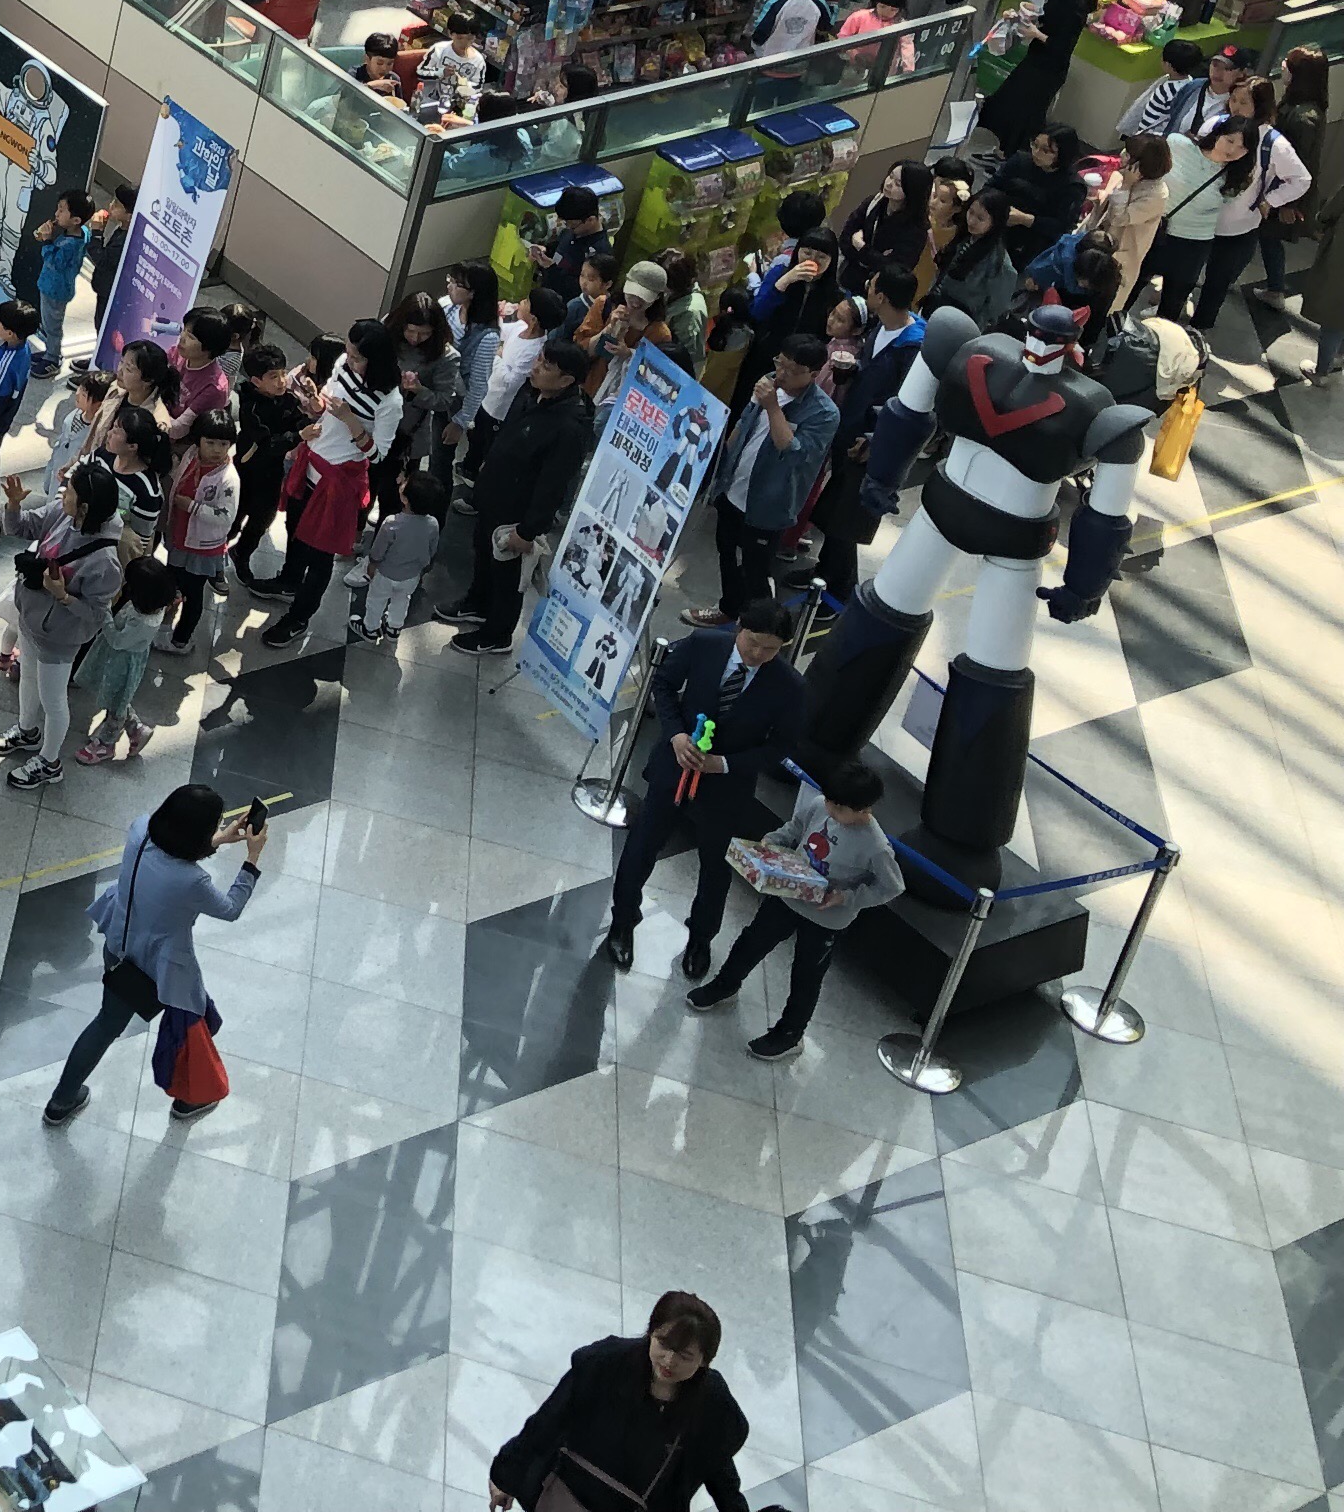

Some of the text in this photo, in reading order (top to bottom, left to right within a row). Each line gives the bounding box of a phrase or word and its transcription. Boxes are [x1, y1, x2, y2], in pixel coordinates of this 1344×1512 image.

[191, 135, 223, 172] 과학의
[209, 139, 226, 157] 2019
[204, 166, 220, 189] 날
[160, 211, 193, 249] 포토존
[623, 387, 670, 437] 로보트
[609, 429, 652, 473] 제작과정
[617, 412, 660, 455] 태권브이
